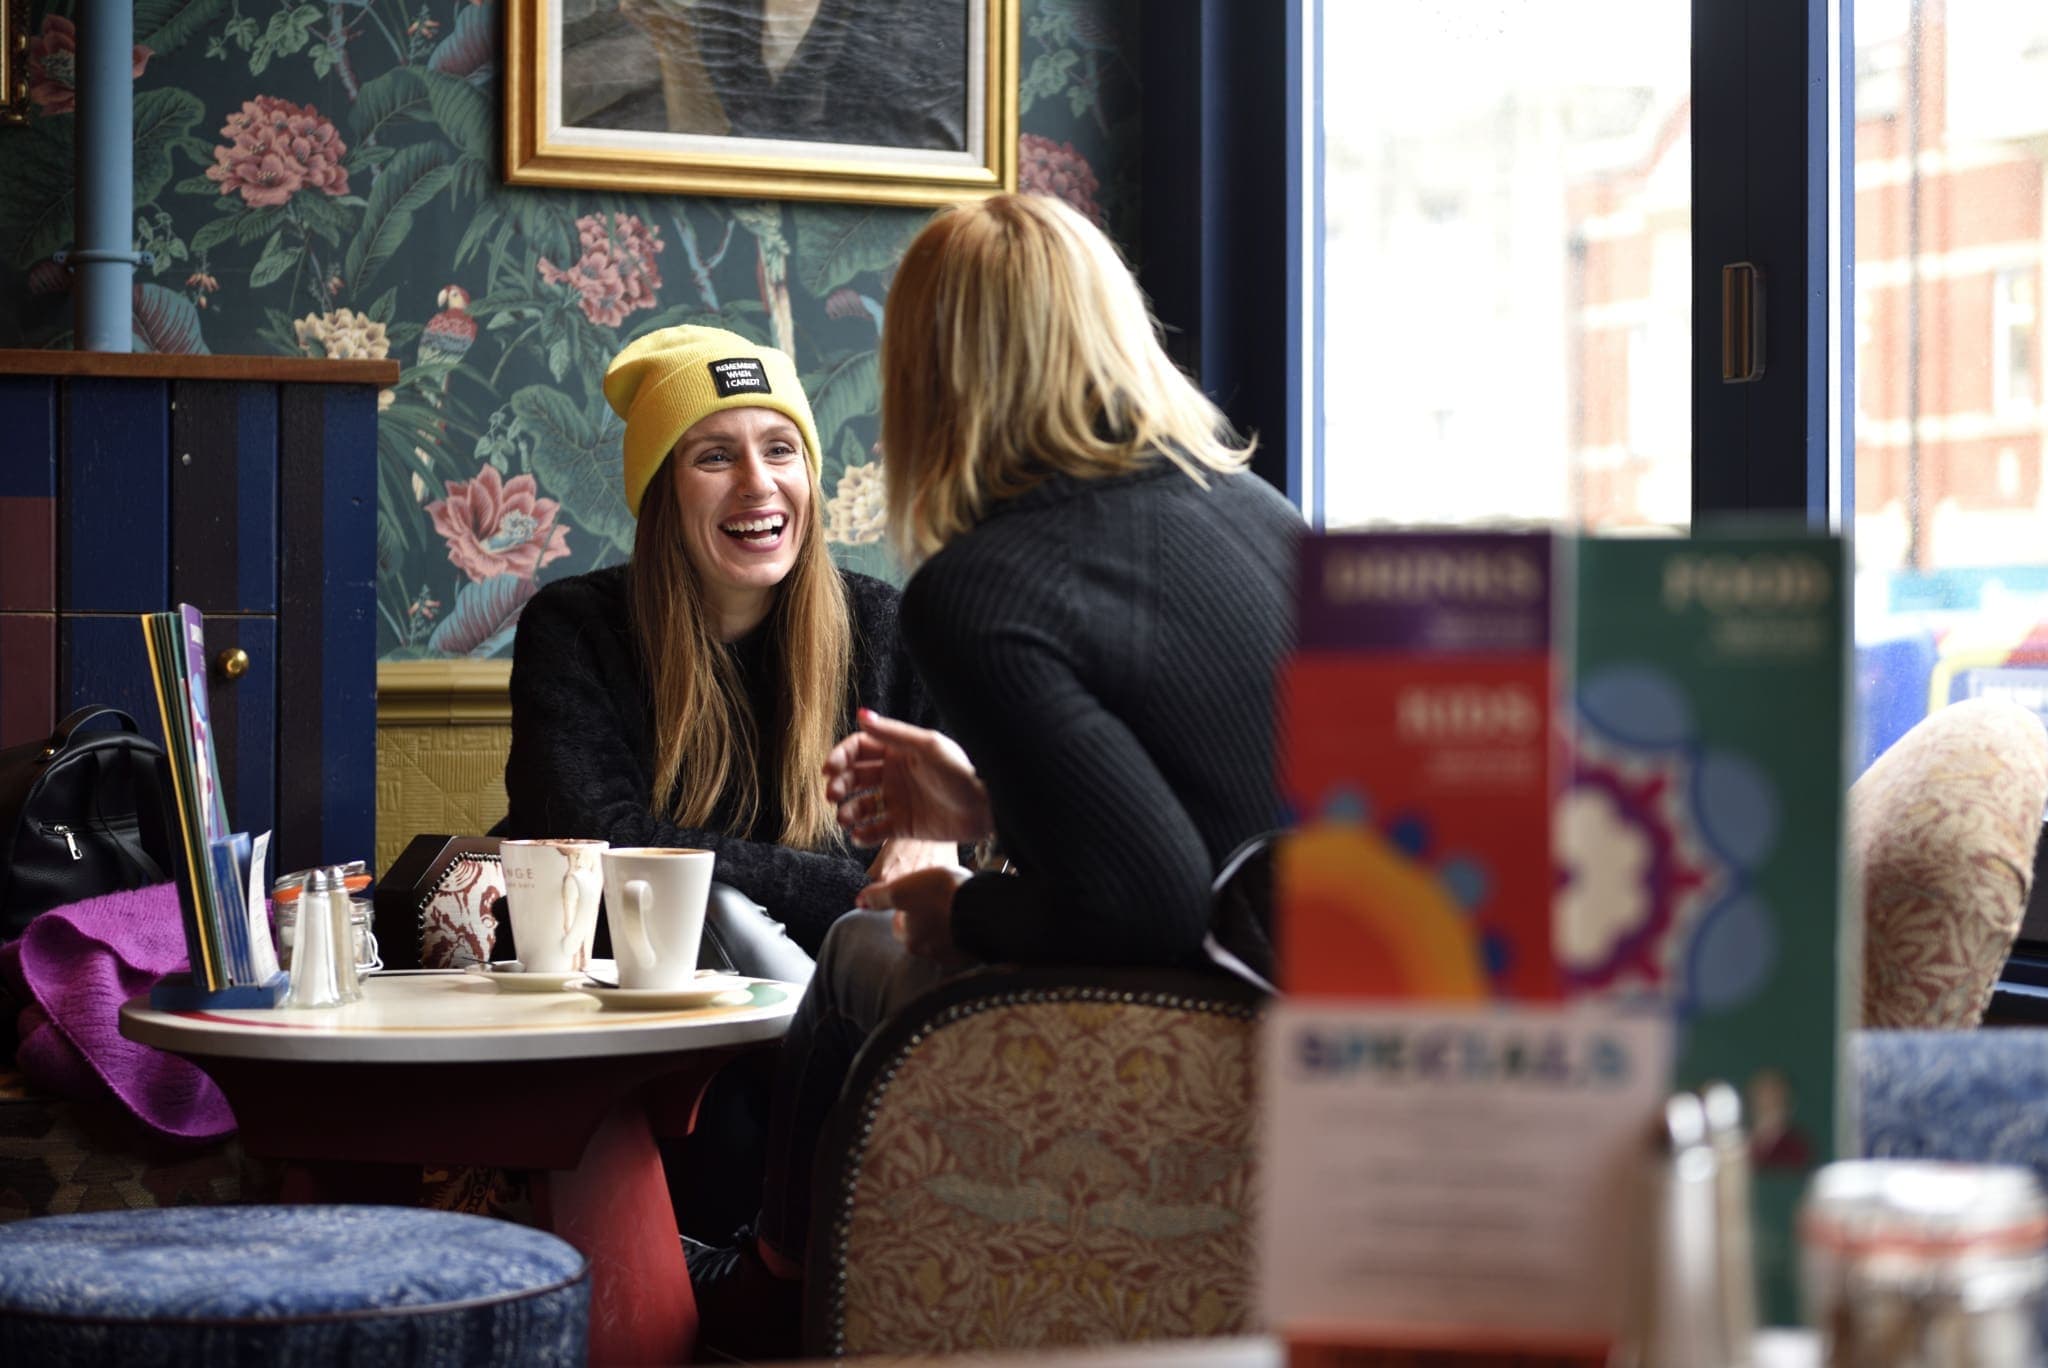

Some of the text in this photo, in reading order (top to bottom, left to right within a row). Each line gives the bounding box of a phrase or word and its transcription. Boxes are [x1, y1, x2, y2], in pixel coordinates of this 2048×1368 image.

[716, 362, 758, 372] REMEMBER
[726, 370, 752, 378] WHEN
[726, 378, 760, 388] I CARED?
[1321, 549, 1542, 602] DRINKS
[1662, 554, 1831, 612] FOOD
[1397, 685, 1540, 741] KIDS
[1292, 1024, 1634, 1085] SPECIALS
